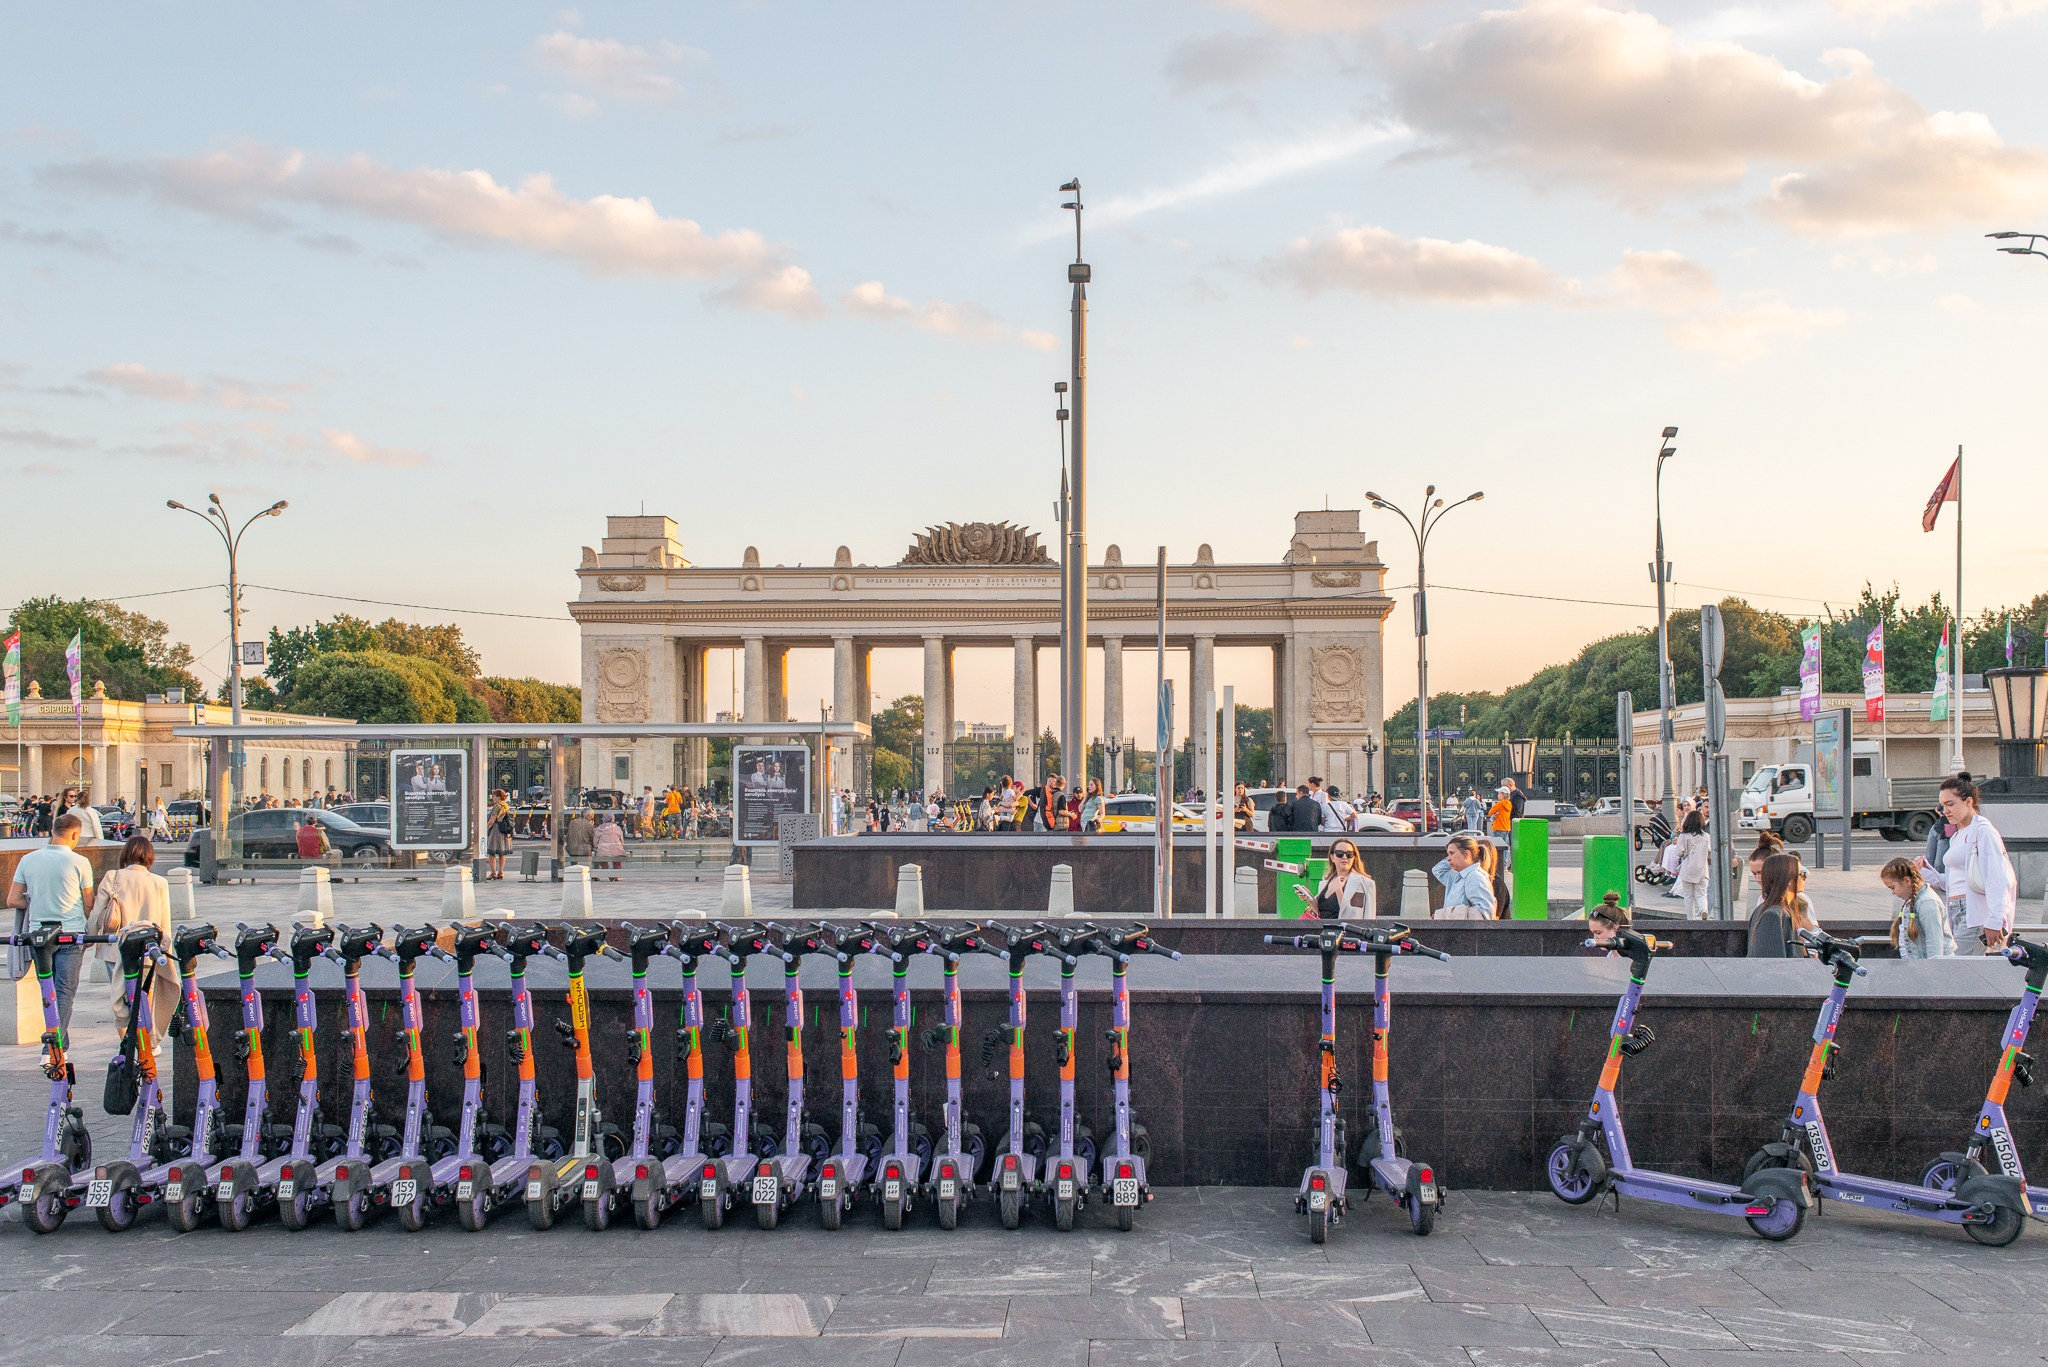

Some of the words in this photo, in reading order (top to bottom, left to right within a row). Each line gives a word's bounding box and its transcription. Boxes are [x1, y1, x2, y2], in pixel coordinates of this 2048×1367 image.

[576, 981, 586, 1028] WHOOSH
[1622, 998, 1630, 1018] ЮРЕНТ
[1831, 1003, 1840, 1023] ЮРЕНТ
[2018, 1008, 2028, 1029] ЮРЕНТ
[142, 1108, 155, 1151] 425938
[91, 1182, 110, 1192] 155
[395, 1182, 414, 1192] 159
[755, 1179, 775, 1190] 152
[1116, 1180, 1136, 1192] 139
[88, 1193, 108, 1205] 792
[394, 1194, 413, 1204] 172
[754, 1190, 775, 1201] 022
[1116, 1192, 1136, 1203] 889
